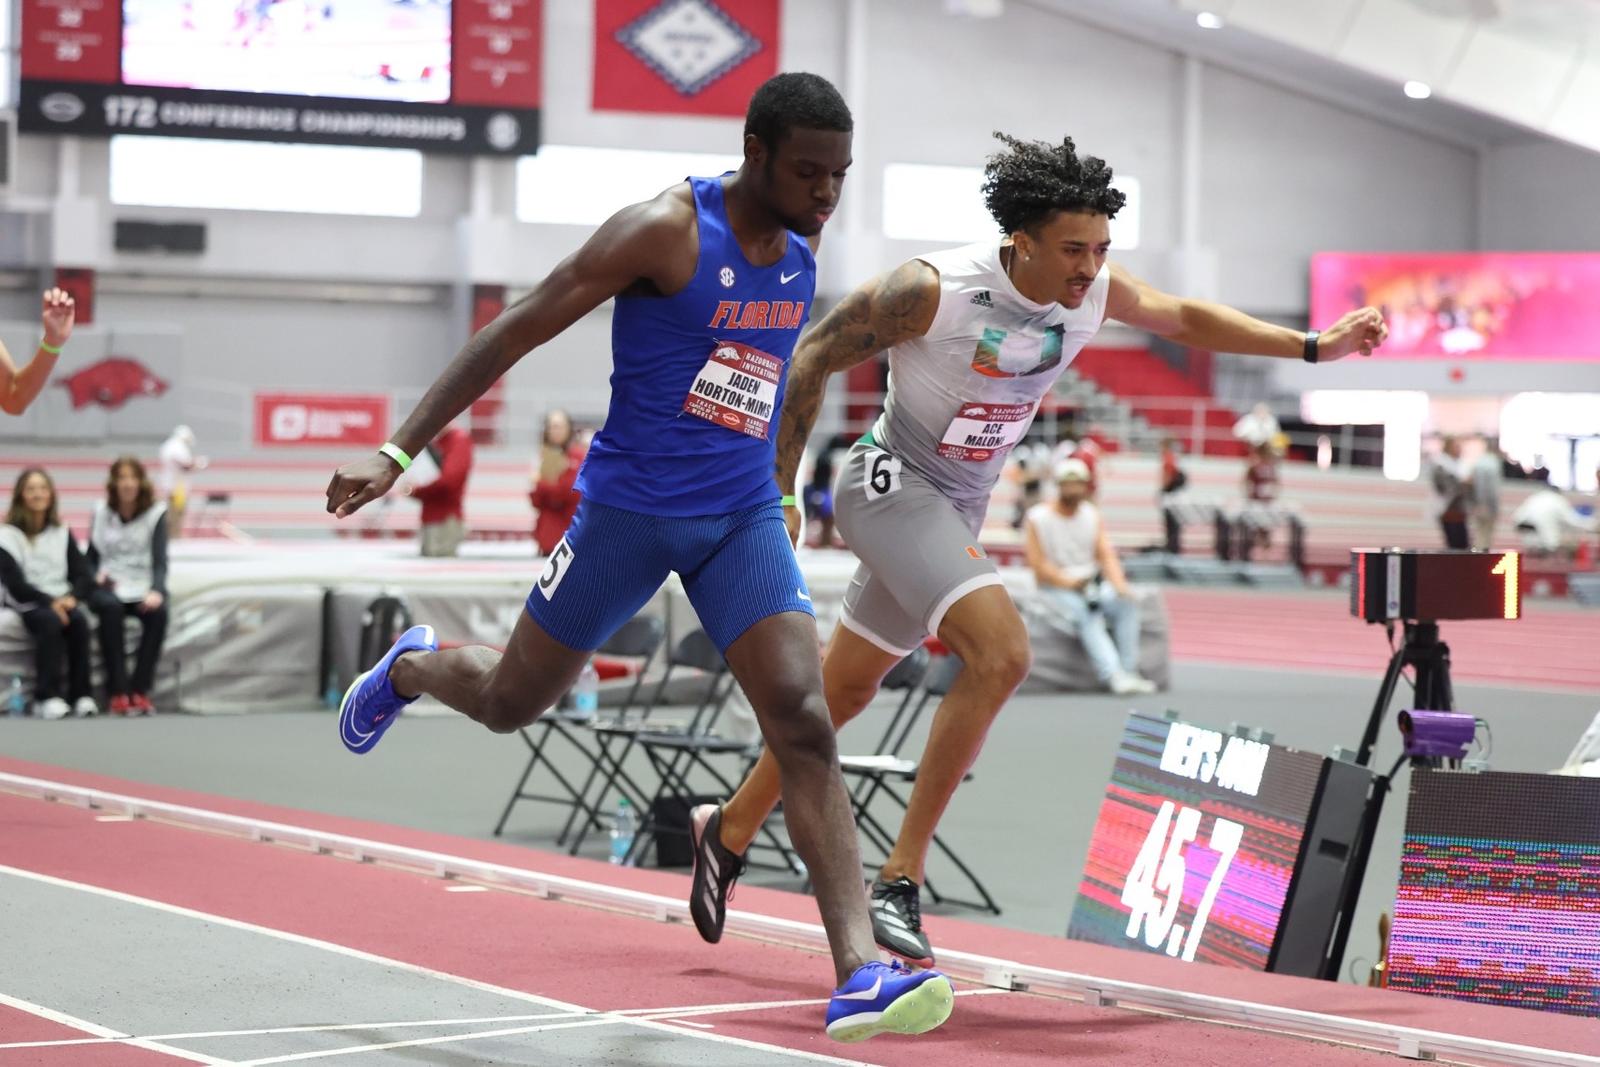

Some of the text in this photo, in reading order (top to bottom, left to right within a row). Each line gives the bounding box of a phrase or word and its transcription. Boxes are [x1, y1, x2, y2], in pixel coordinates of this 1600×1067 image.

[103, 95, 158, 128] 172
[160, 101, 297, 132] CONFERENCE
[300, 108, 466, 141] CHAMPIONSHIPS
[719, 267, 736, 287] SEC
[707, 300, 804, 329] FLORIDA
[745, 352, 778, 371] RAZORBACK
[694, 378, 772, 419] HORTON-MIMS
[727, 372, 761, 395] JADEN
[982, 423, 1005, 435] ACE
[871, 453, 893, 495] 6
[540, 543, 569, 589] 5
[1491, 551, 1517, 619] 1
[1121, 800, 1244, 963] 45.7
